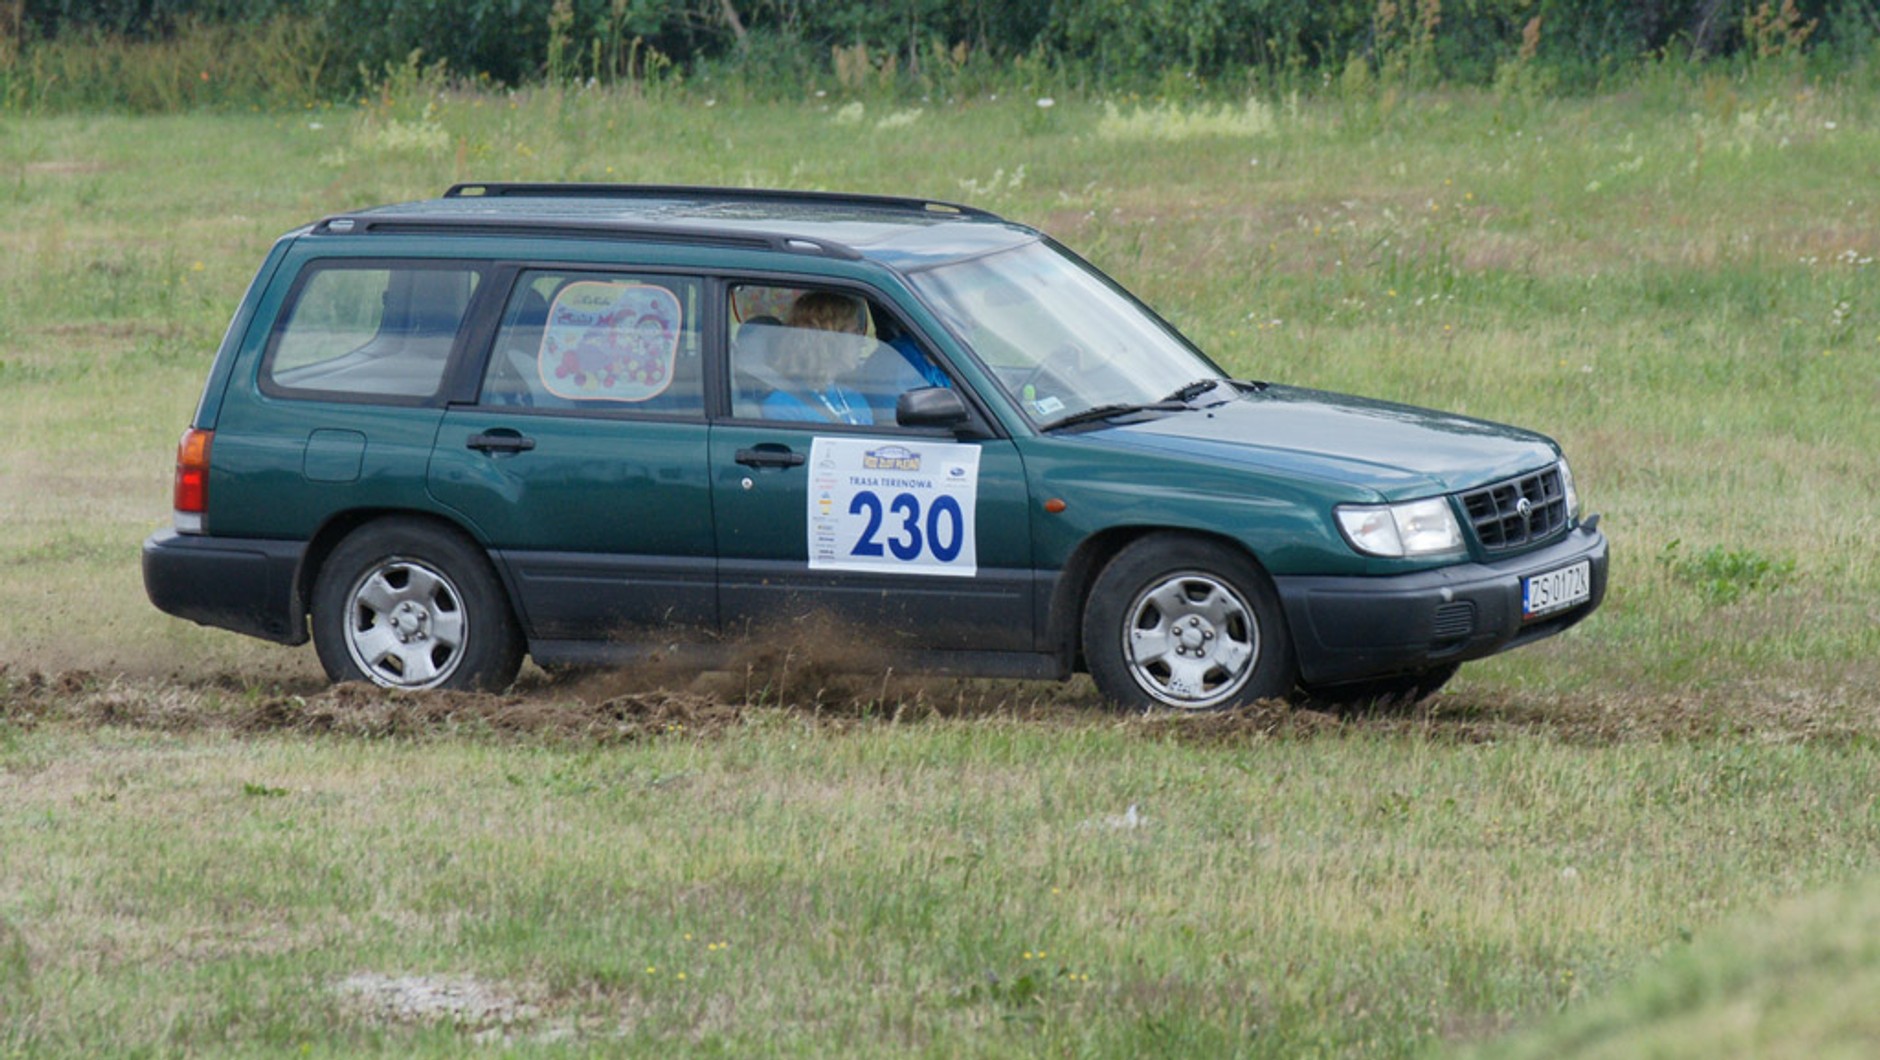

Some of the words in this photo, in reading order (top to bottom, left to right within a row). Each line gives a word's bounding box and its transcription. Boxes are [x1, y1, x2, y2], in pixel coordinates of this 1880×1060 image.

[850, 477, 878, 486] TRASA
[881, 479, 932, 488] TERENOWA
[849, 490, 963, 562] 230
[1531, 577, 1548, 608] ZS
